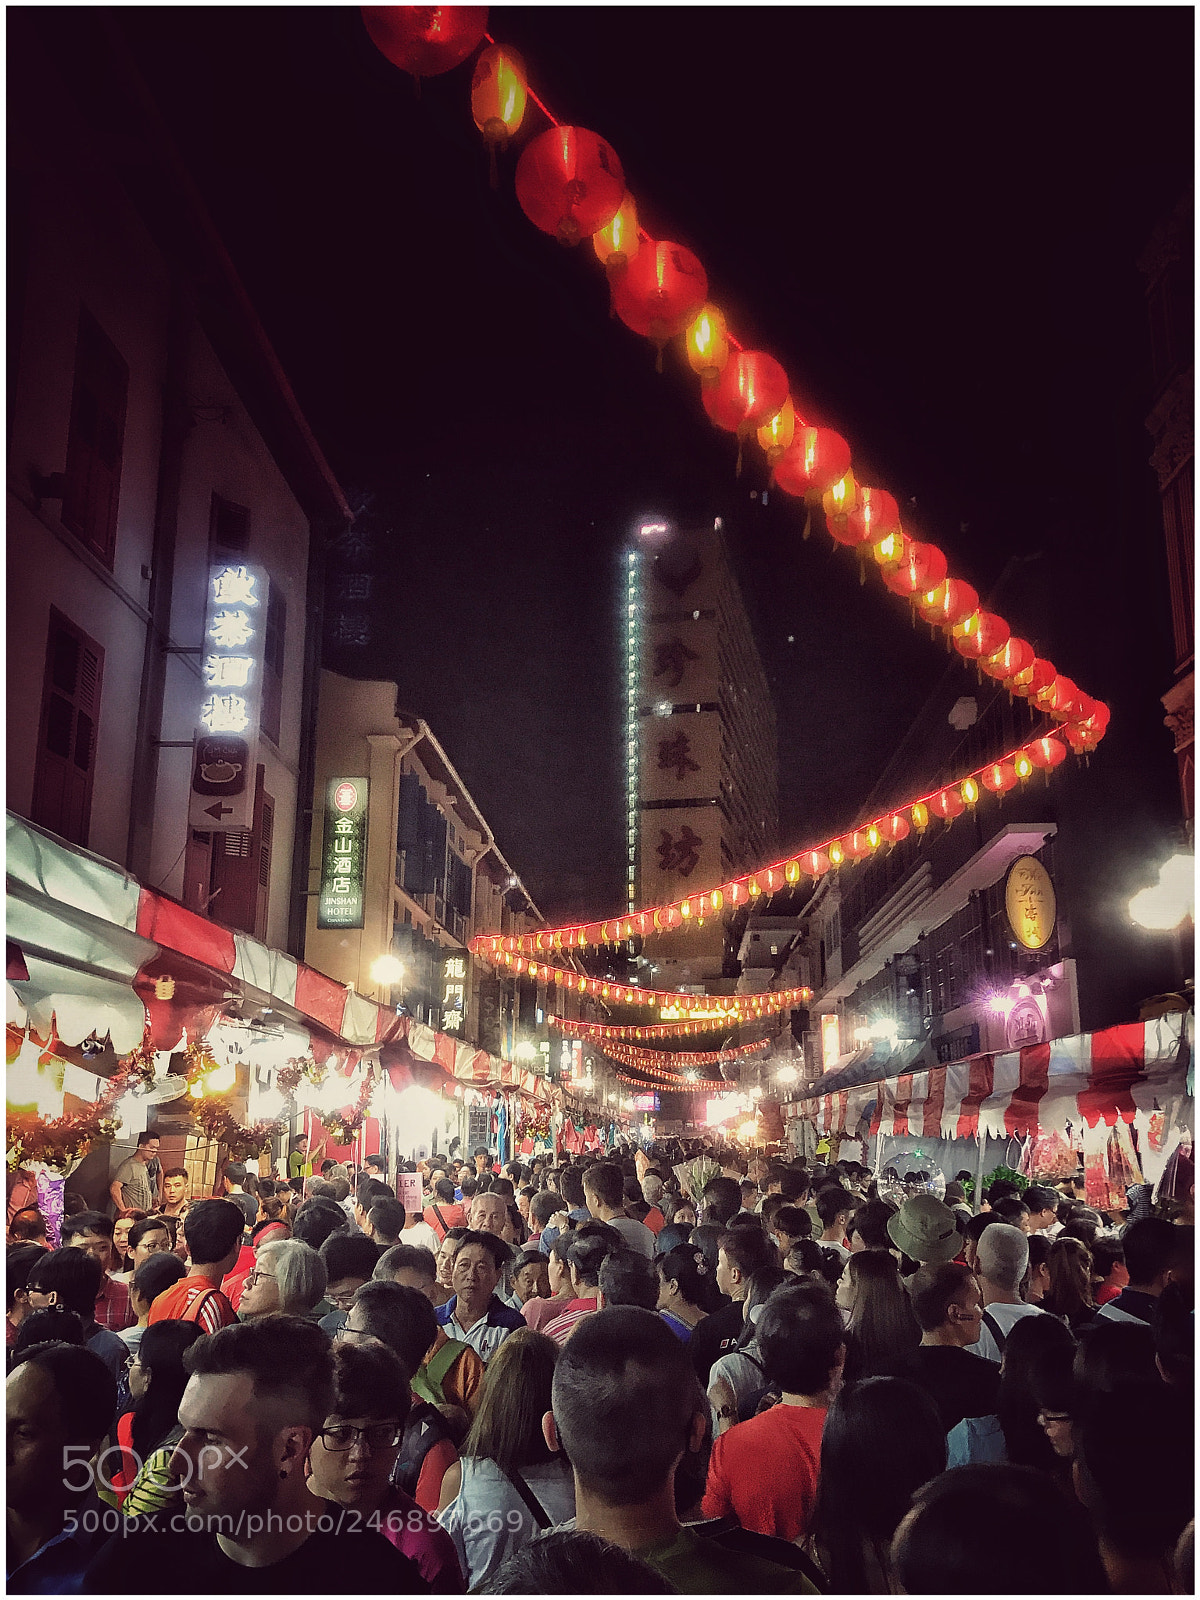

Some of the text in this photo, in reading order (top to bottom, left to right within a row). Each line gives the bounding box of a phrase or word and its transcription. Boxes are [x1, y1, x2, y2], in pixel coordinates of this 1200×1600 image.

[203, 566, 258, 733] 飲茶酒樓
[332, 816, 354, 893] 金山酒店
[324, 897, 358, 905] JINSHAN
[327, 907, 354, 916] HOTEL
